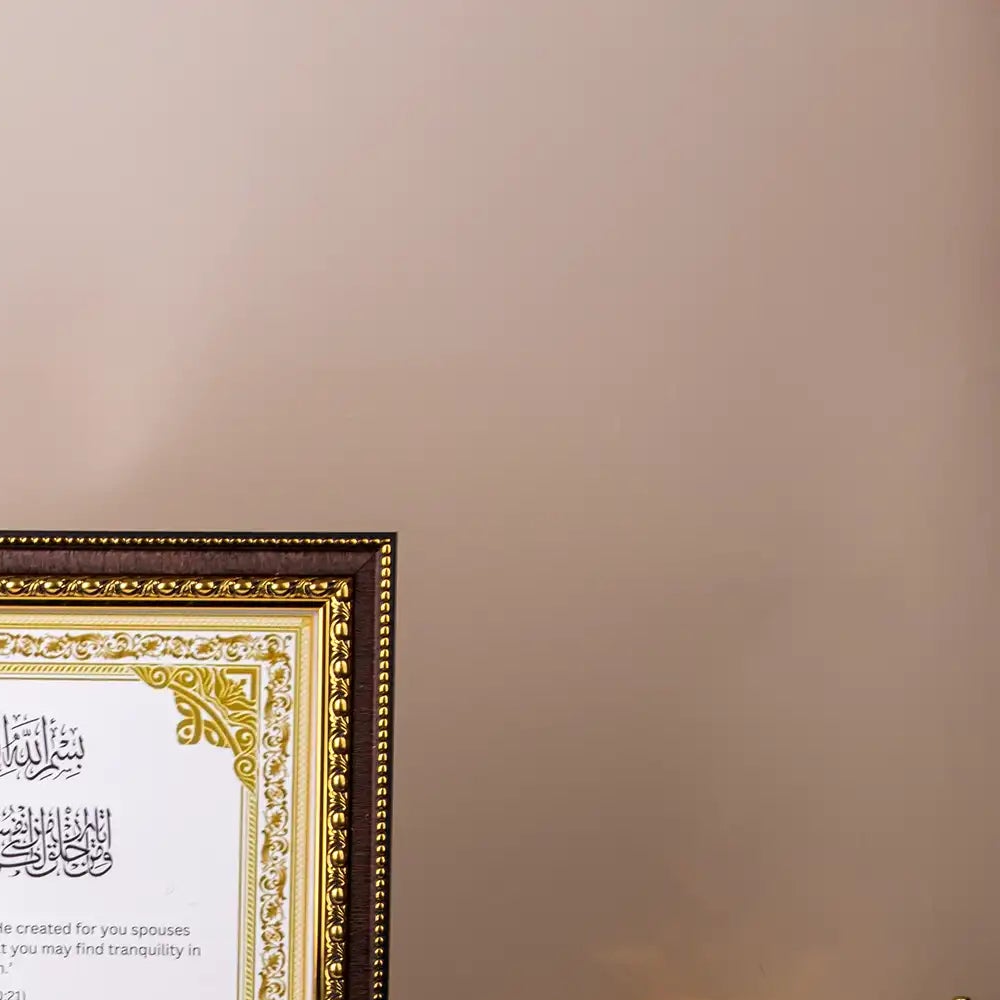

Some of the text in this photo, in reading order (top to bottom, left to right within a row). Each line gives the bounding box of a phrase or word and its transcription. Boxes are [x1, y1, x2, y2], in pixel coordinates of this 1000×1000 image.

[15, 921, 72, 936] created
[75, 920, 98, 936] for
[99, 925, 128, 939] you
[130, 925, 191, 939] spouses
[9, 944, 38, 958] you
[40, 944, 73, 959] may
[75, 941, 105, 956] find
[107, 943, 185, 960] tranquility
[187, 943, 202, 957] in
